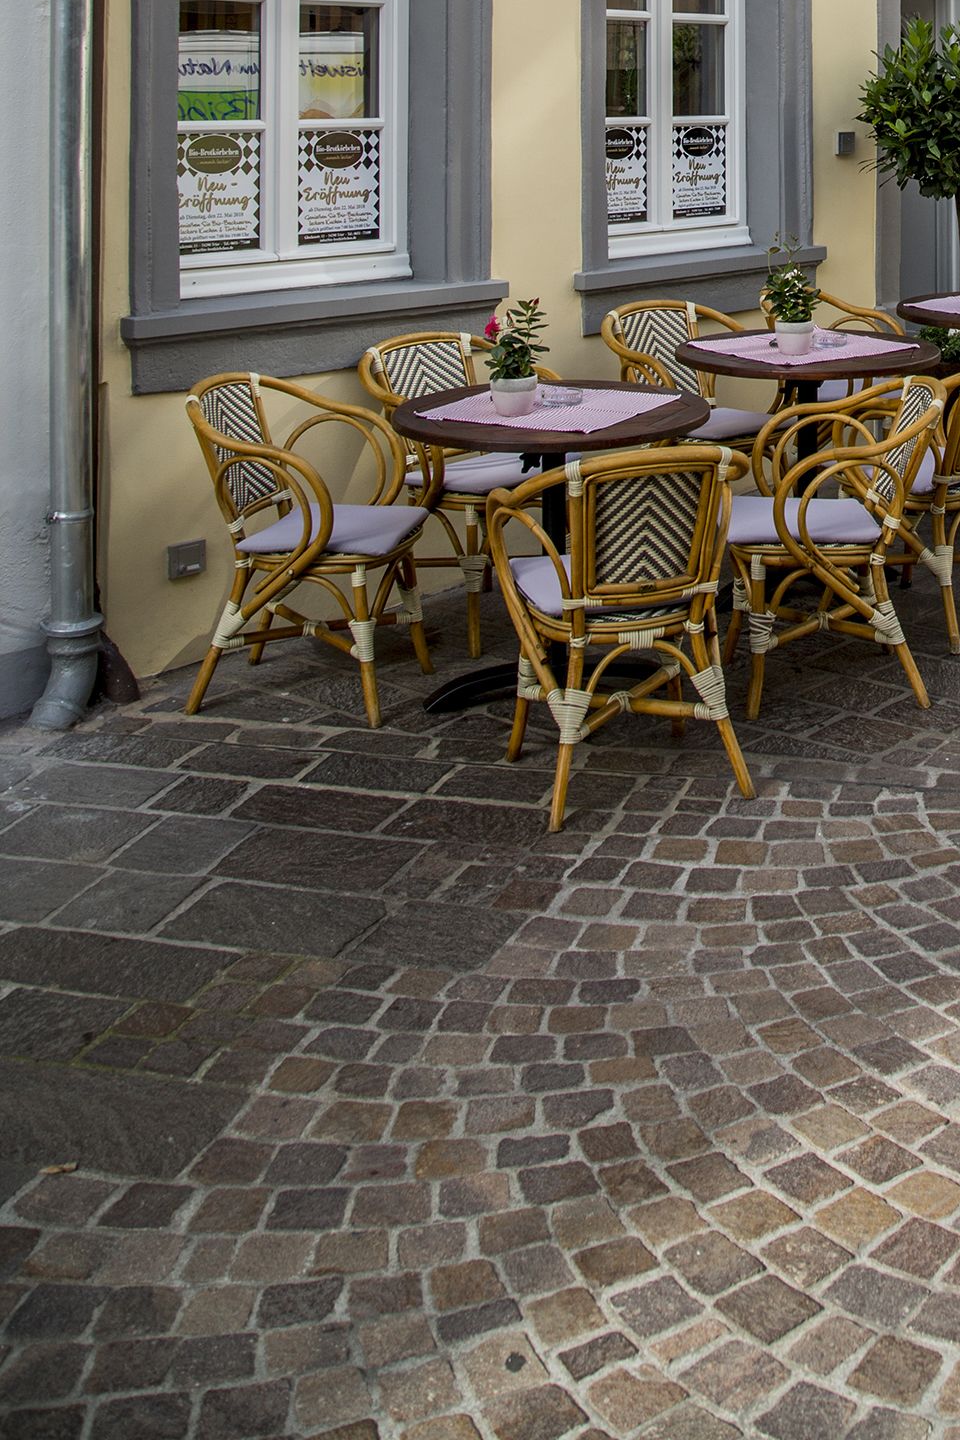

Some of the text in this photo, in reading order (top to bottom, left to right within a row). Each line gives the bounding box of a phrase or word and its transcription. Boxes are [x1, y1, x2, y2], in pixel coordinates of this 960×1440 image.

[197, 176, 227, 193] Neu
[324, 171, 350, 186] Neu
[303, 186, 372, 205] Eröffnung
